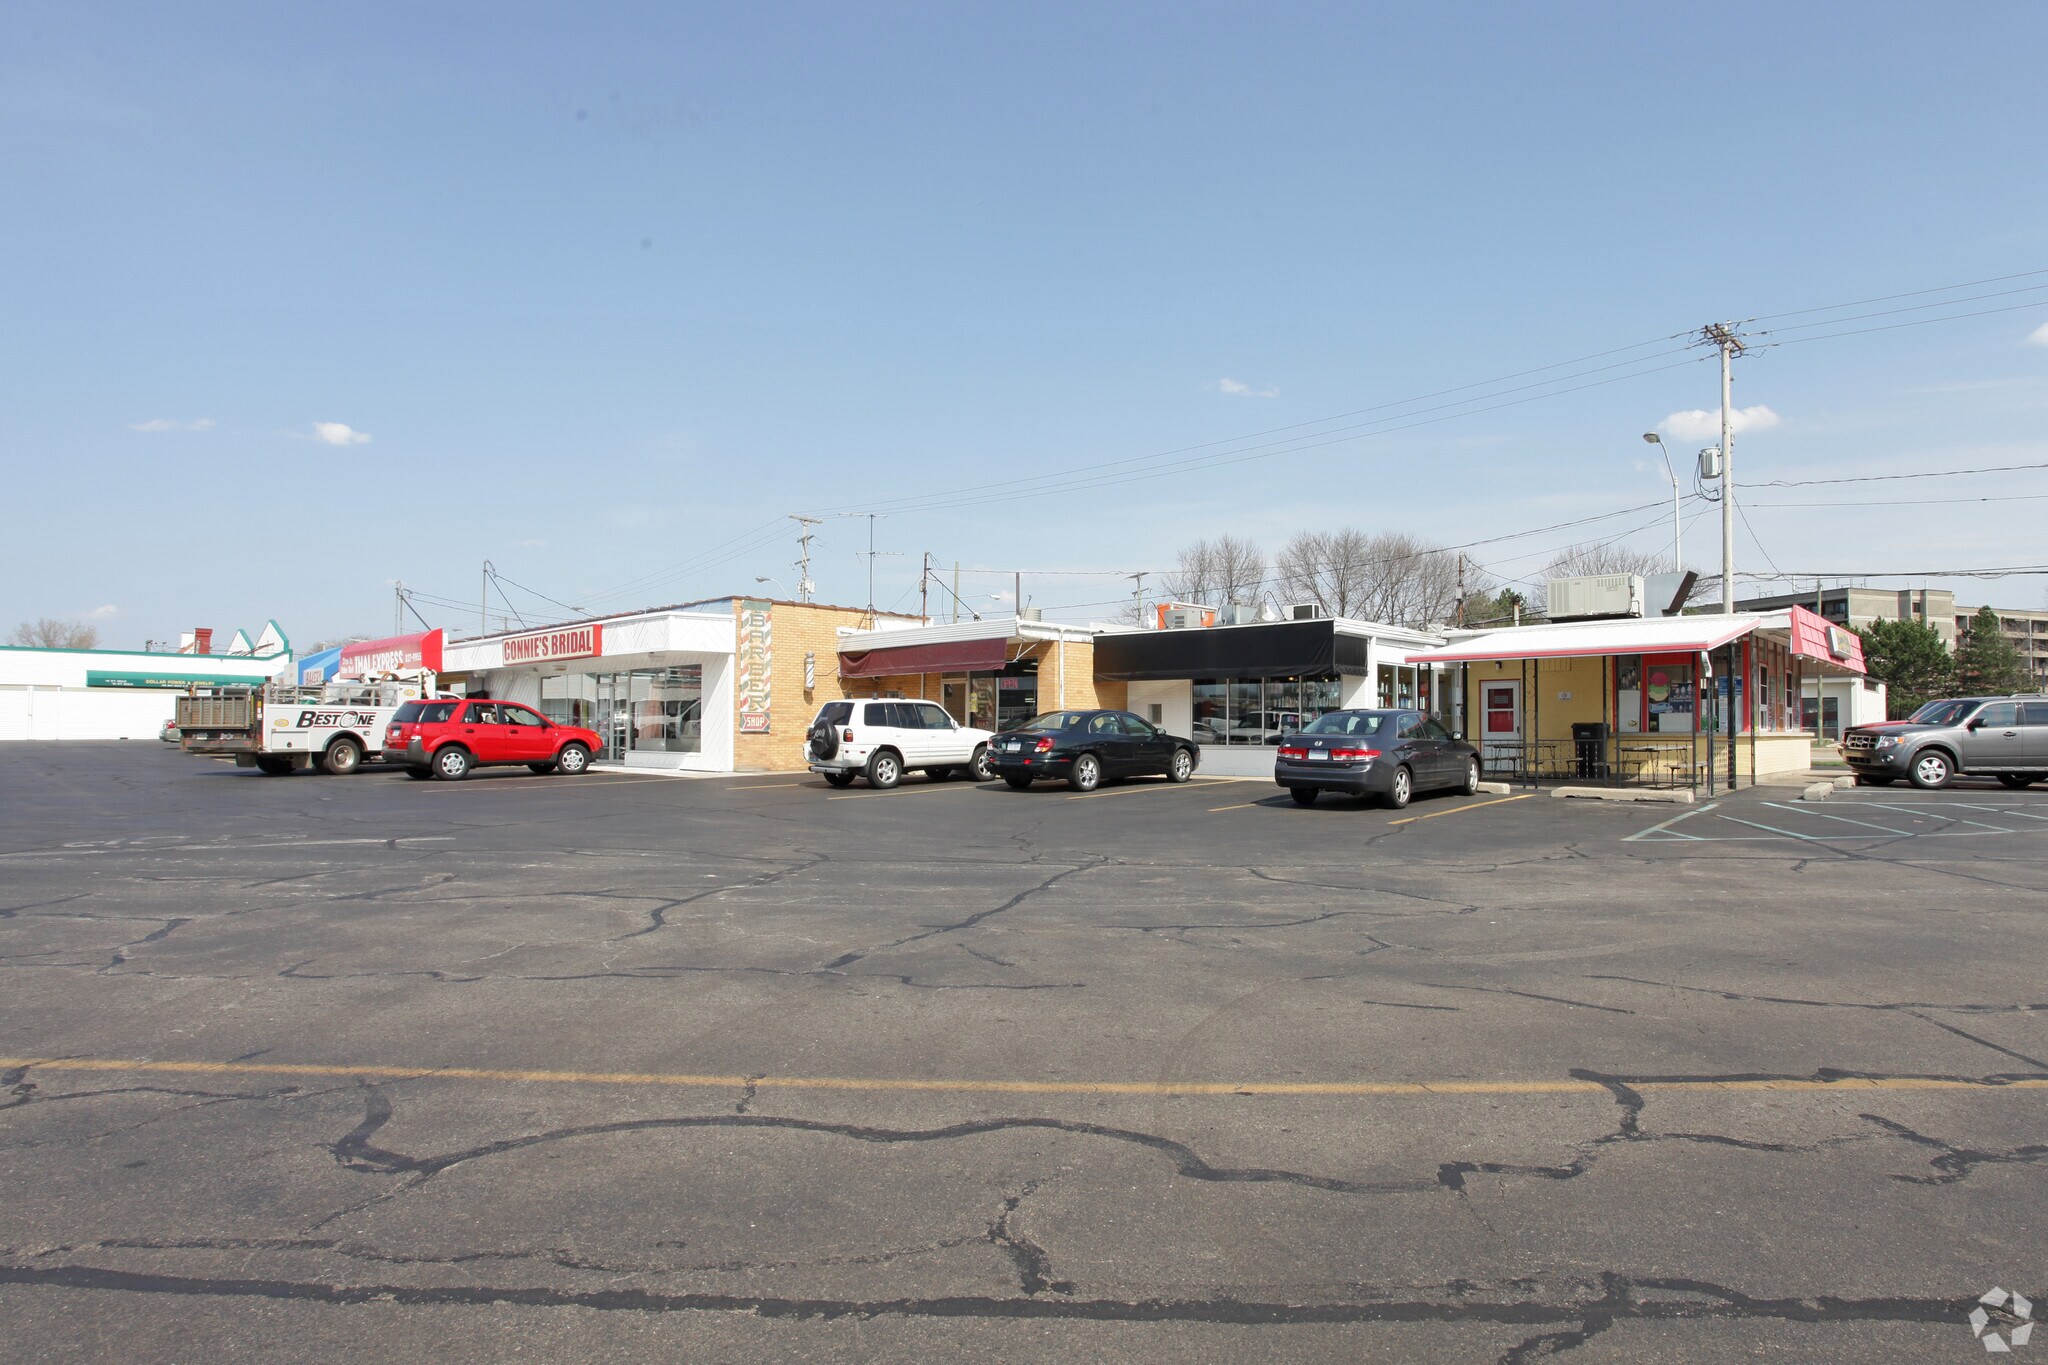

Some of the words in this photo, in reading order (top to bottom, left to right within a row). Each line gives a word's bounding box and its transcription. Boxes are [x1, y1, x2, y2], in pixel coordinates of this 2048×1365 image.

[504, 635, 549, 661] CONNIE'S
[551, 630, 591, 656] BRIDAL
[355, 653, 371, 674] THAI
[372, 650, 403, 671] EXPRESS
[748, 613, 765, 709] BARBER
[746, 717, 765, 727] SHOP
